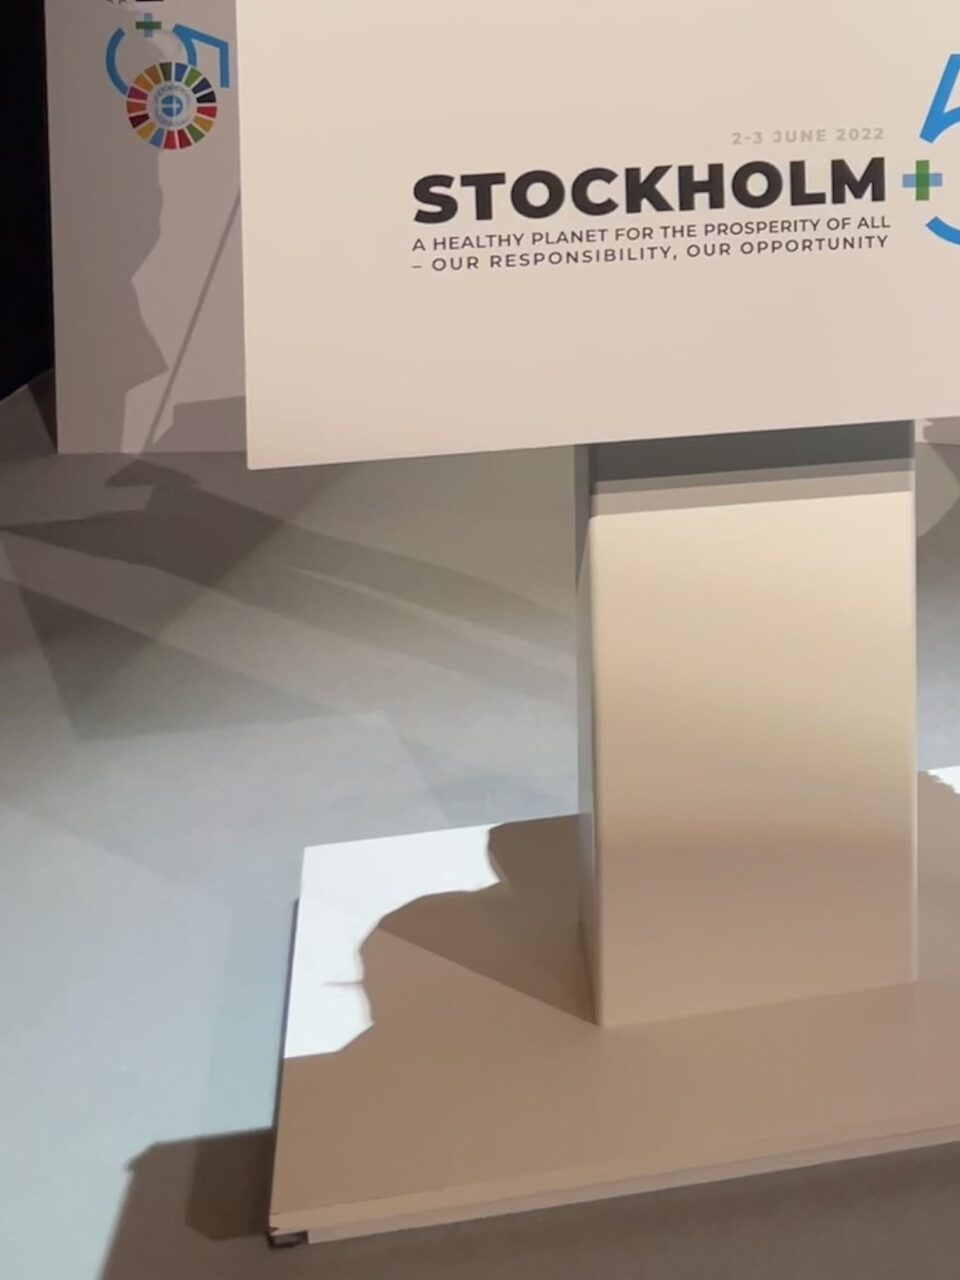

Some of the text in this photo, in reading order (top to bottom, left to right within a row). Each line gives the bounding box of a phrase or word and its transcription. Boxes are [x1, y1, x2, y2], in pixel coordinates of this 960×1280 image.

[731, 127, 885, 145] 2-3 JUNE 2022
[413, 157, 886, 224] STOCKHOLM
[412, 216, 891, 252] A HEALTHY PLANET FOR THE PROSPERITY OF ALL
[432, 256, 479, 272] OUR
[490, 246, 678, 269] RESPONSIBILITY,
[686, 242, 732, 258] OUR
[740, 235, 889, 256] OPPORTUNITY
